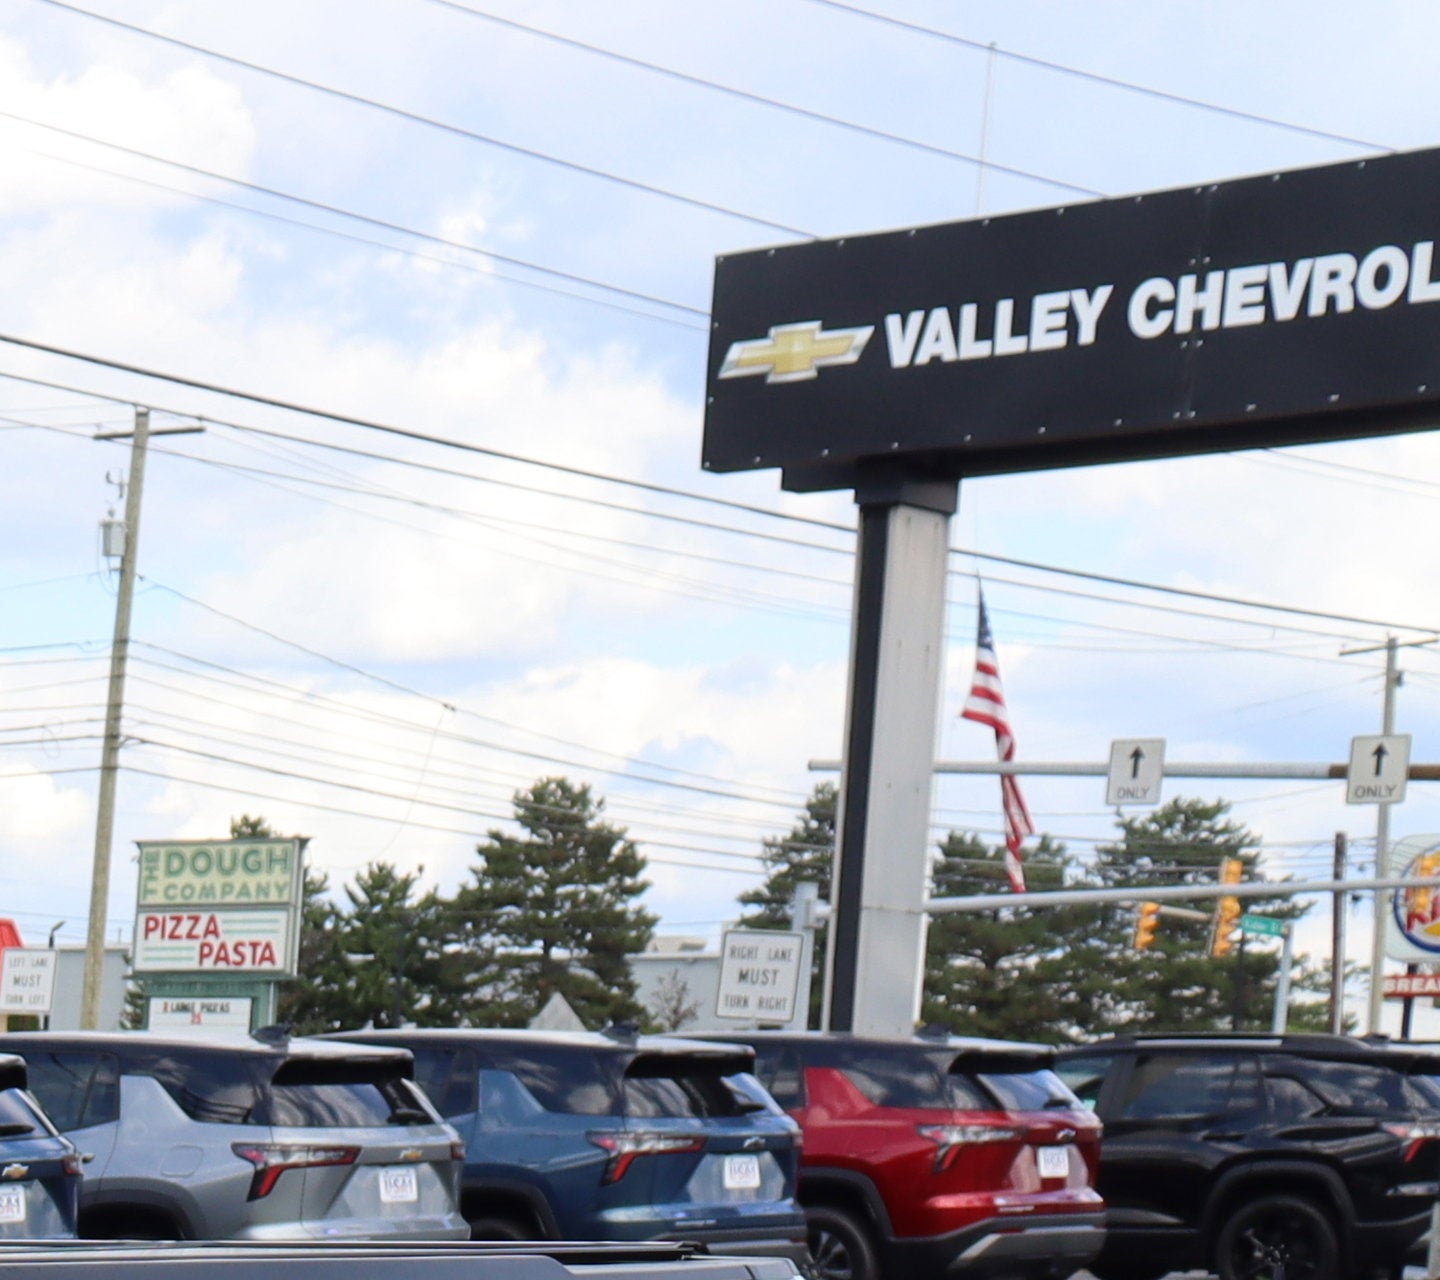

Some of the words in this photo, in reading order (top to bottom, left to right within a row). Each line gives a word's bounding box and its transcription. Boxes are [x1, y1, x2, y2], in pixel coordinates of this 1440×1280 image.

[884, 284, 1114, 369] VALLEY
[1116, 785, 1151, 800] ONLY
[1354, 784, 1399, 799] ONLY
[166, 848, 290, 877] DOUGH
[143, 850, 161, 900] THE
[163, 882, 289, 901] COMPANY
[143, 914, 221, 941] PIZZA
[198, 941, 278, 967] PASTA
[729, 944, 759, 961] RIGHT
[767, 947, 793, 963] LANE
[13, 973, 42, 987] MUST
[738, 966, 779, 986] MUST
[758, 995, 789, 1011] RIGHT
